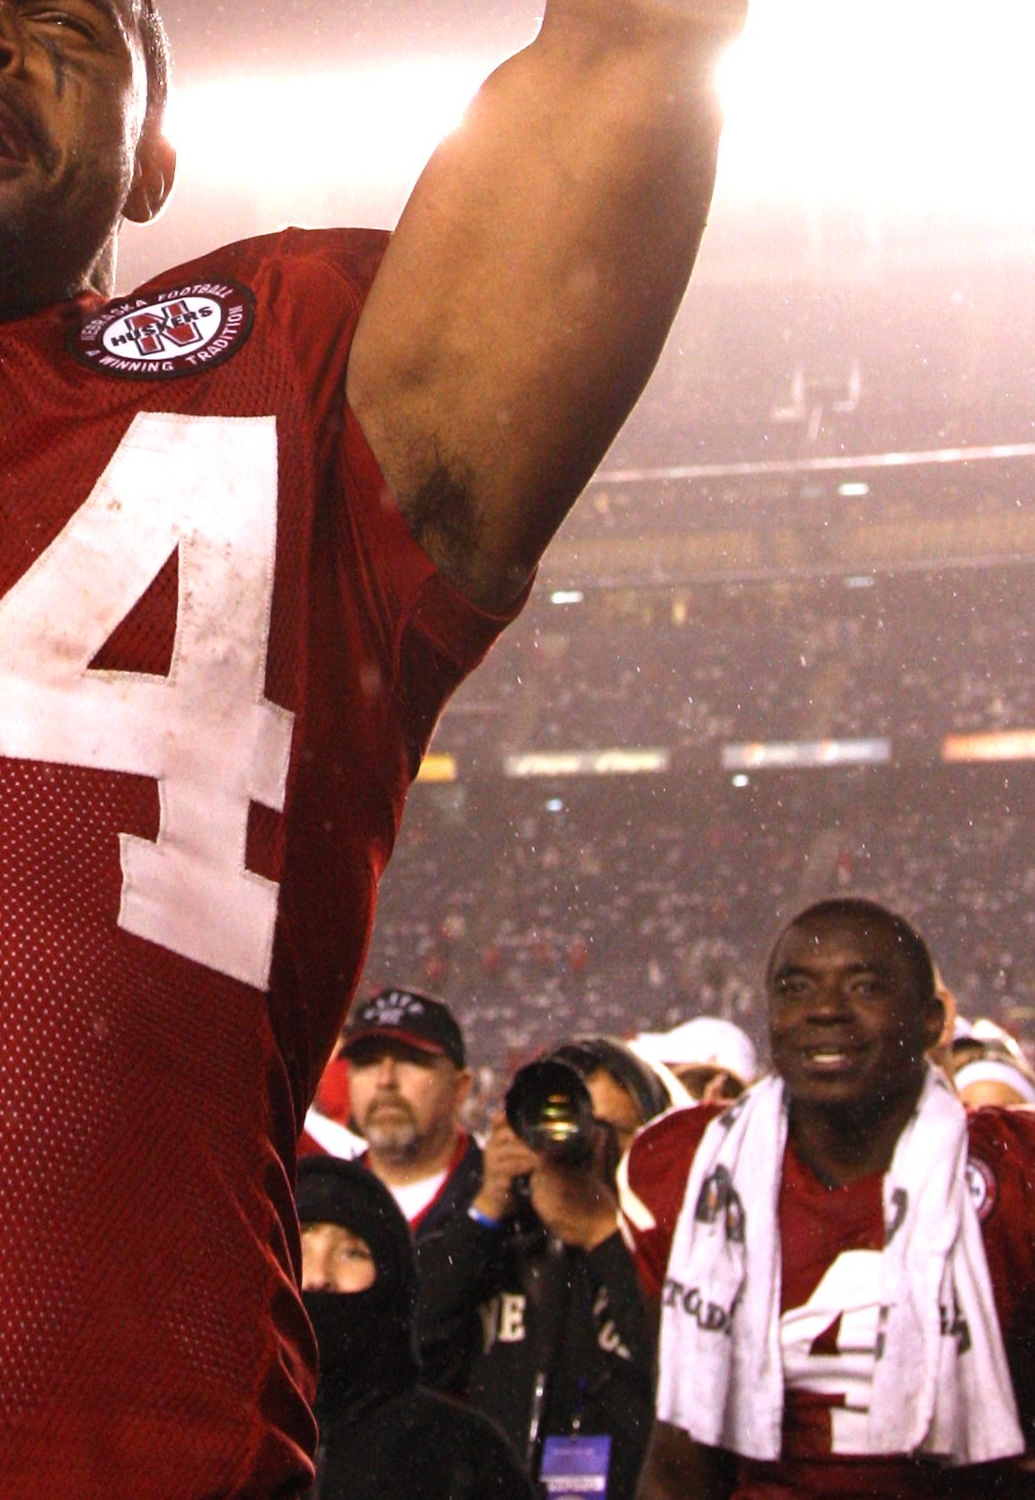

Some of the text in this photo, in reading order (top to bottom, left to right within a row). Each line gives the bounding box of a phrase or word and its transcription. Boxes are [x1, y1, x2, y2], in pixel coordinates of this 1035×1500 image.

[80, 283, 234, 341] NEBRASKA FOOTBALL
[98, 355, 174, 373] WINNING
[185, 304, 244, 366] TRADITION
[111, 306, 213, 347] HUSKERS
